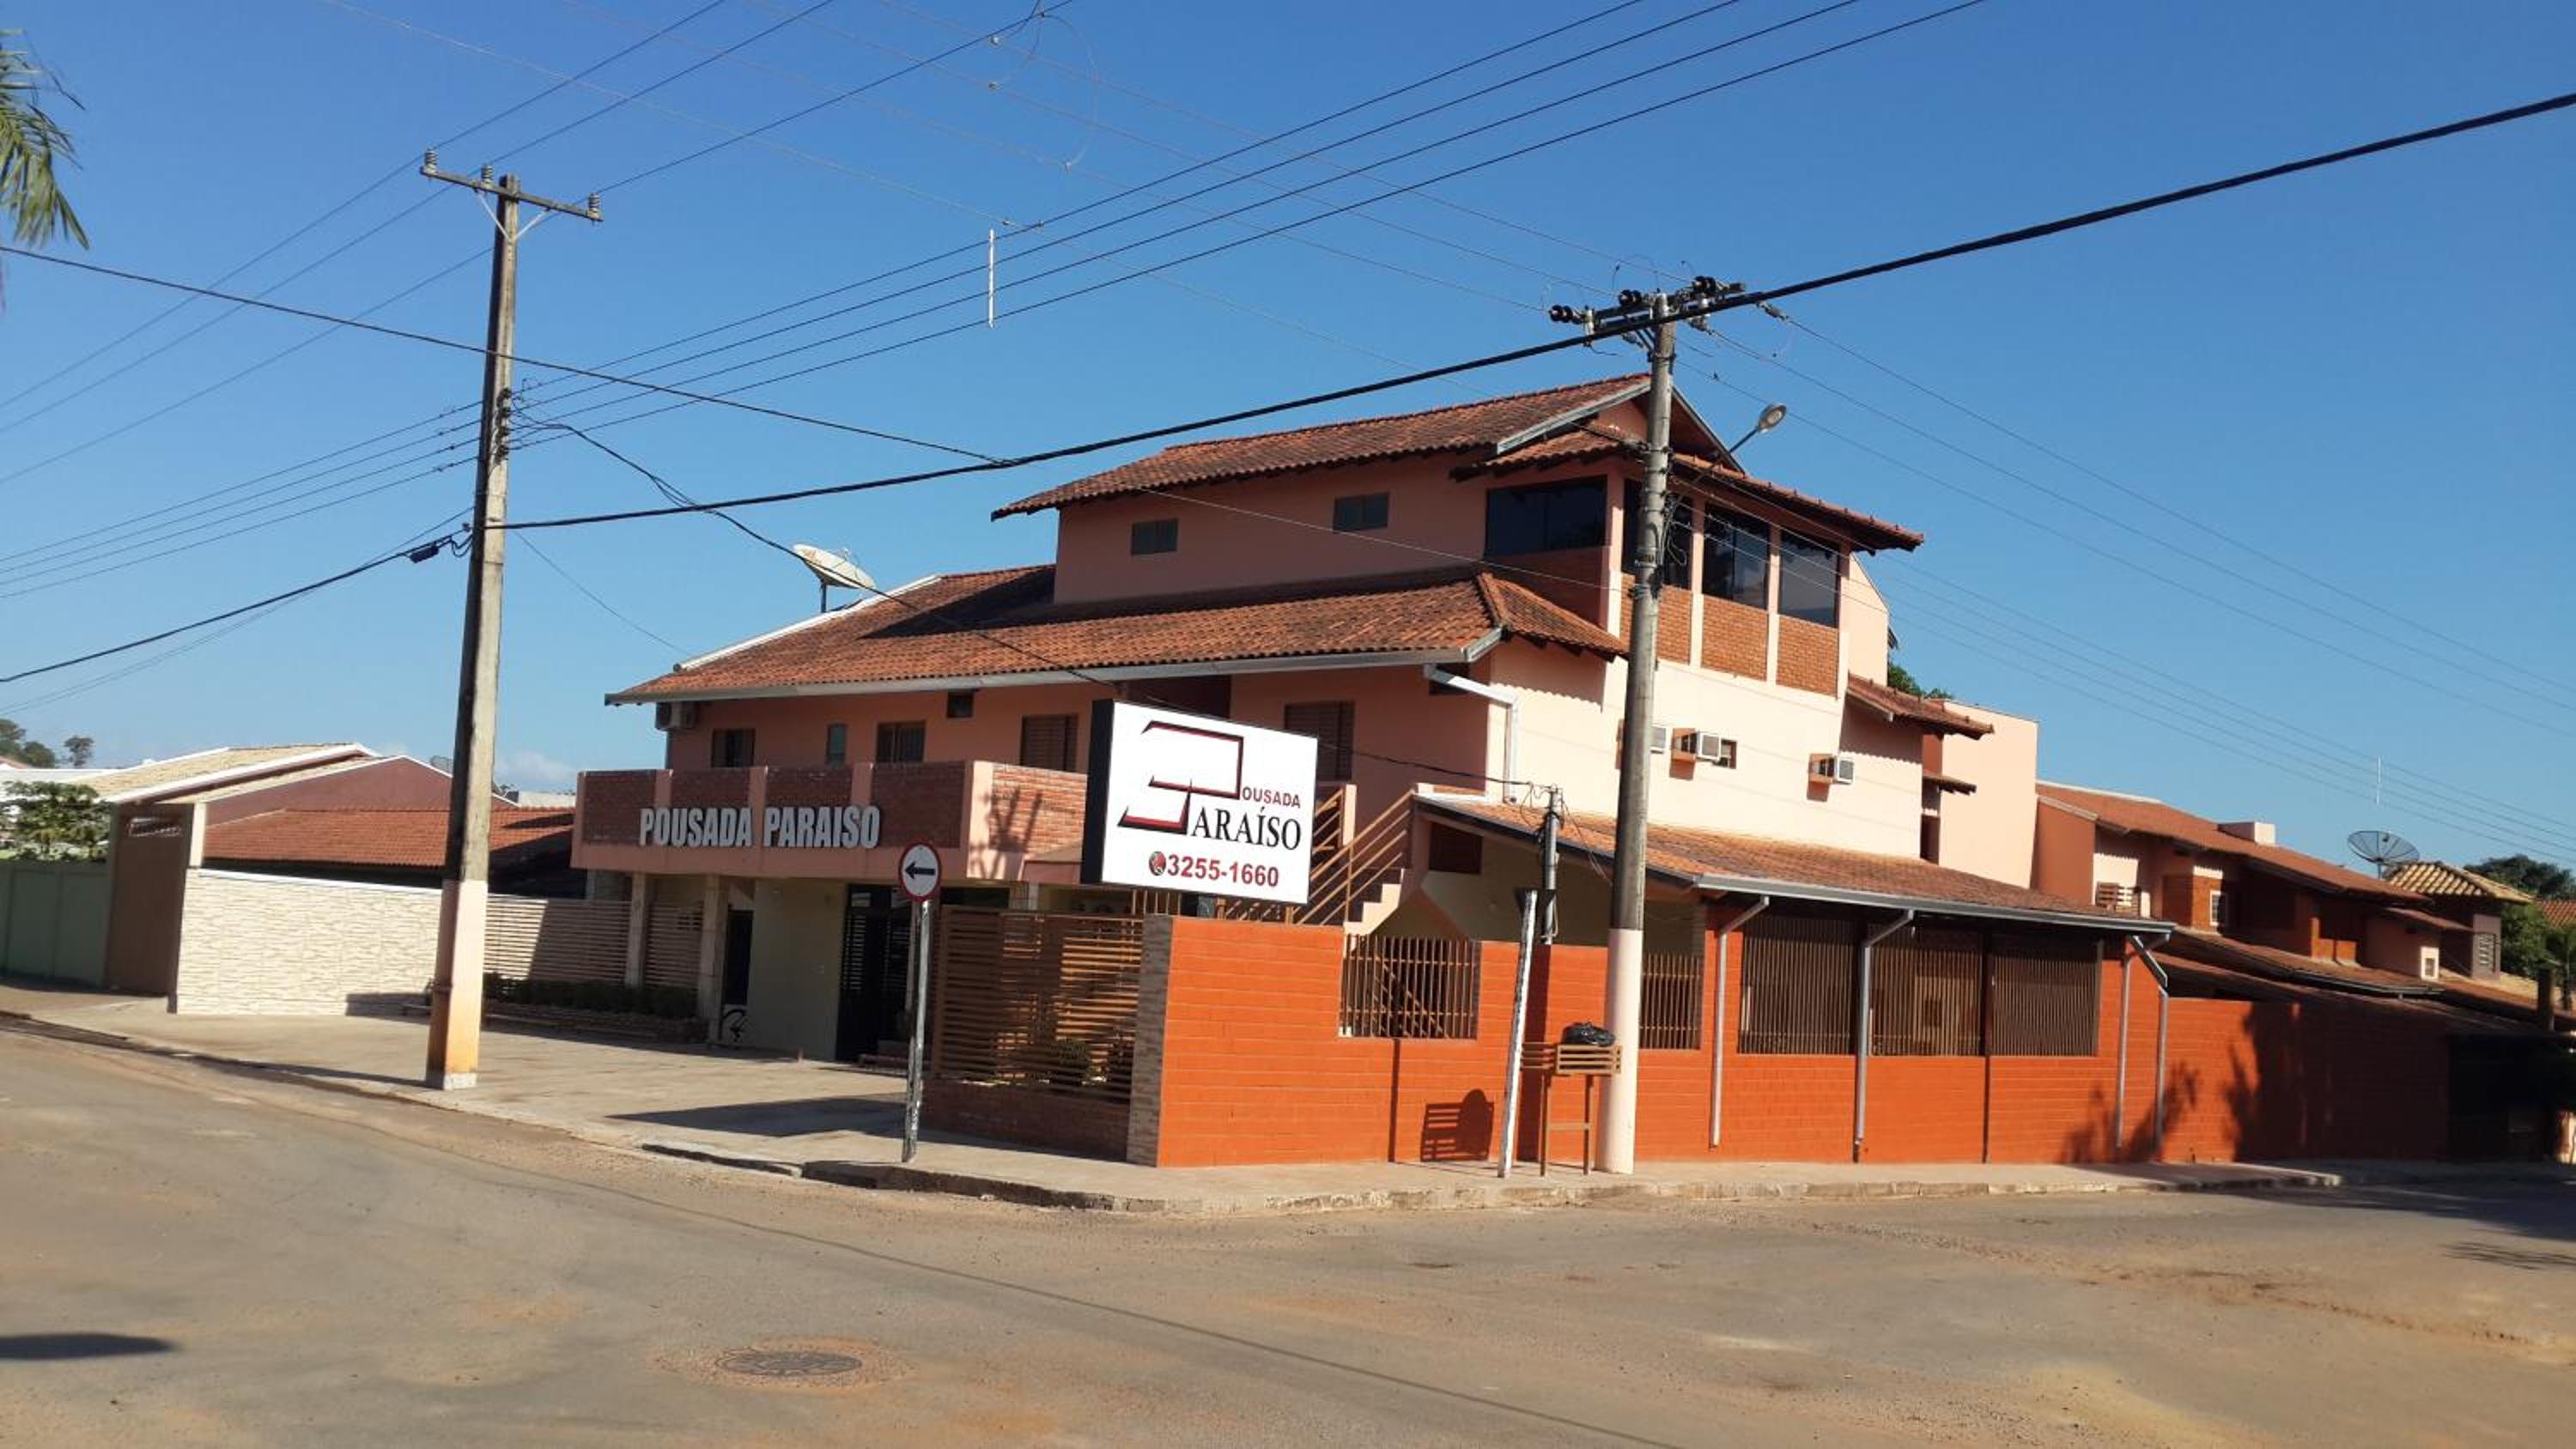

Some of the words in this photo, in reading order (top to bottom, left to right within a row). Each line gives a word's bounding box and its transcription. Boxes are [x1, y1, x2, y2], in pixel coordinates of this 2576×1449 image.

[640, 808, 752, 847] POUSADA
[763, 806, 880, 849] PARAISO
[1168, 854, 1279, 887] 3255-1660
